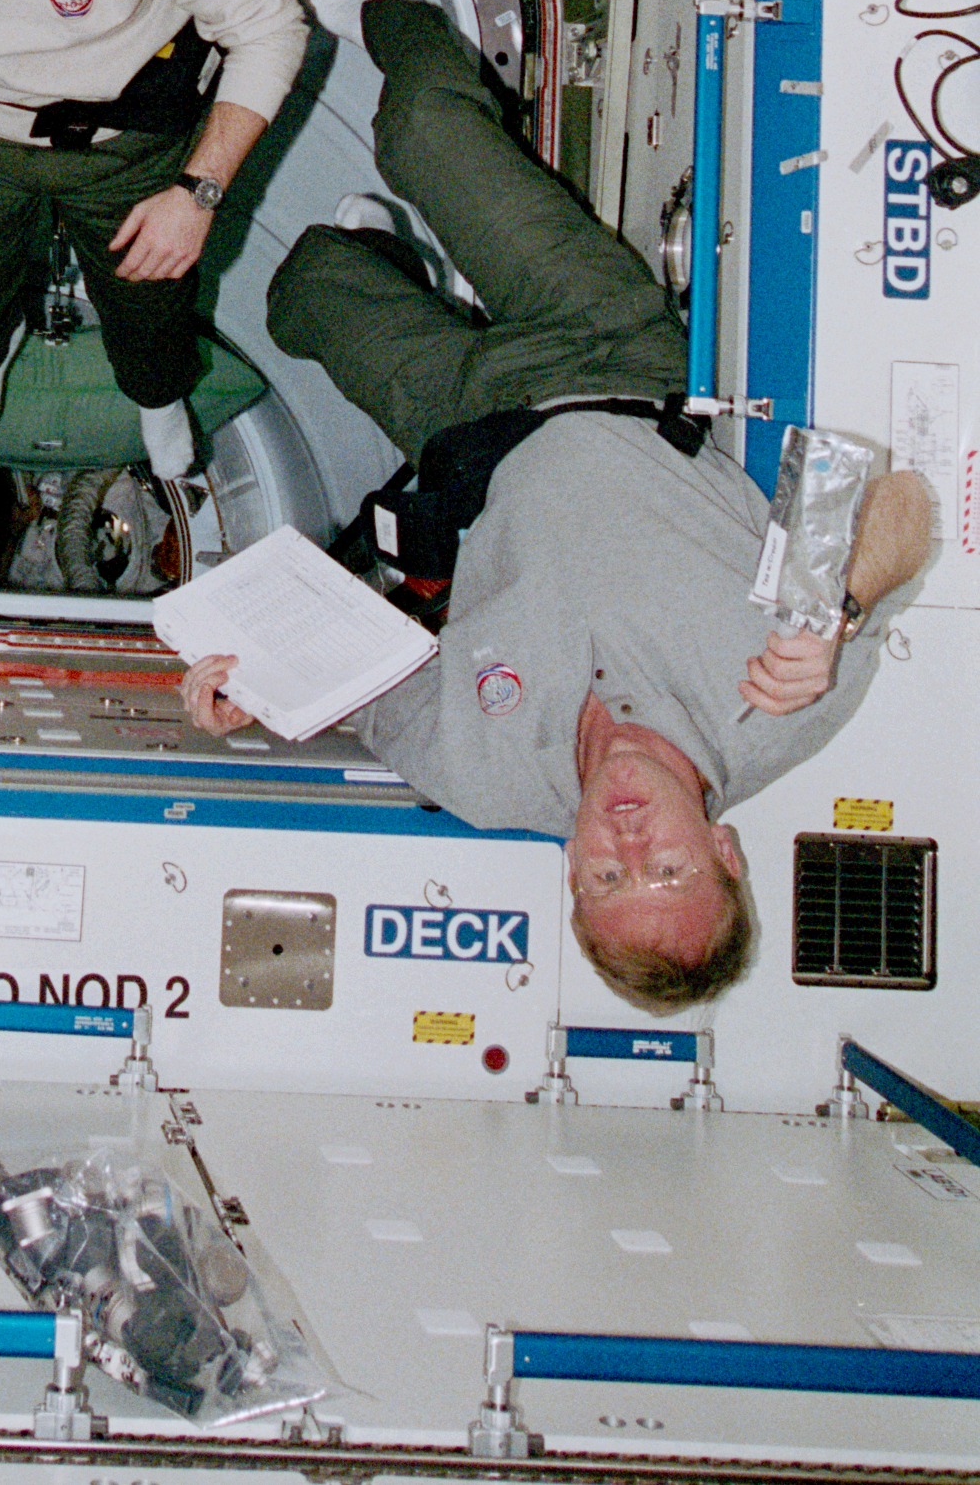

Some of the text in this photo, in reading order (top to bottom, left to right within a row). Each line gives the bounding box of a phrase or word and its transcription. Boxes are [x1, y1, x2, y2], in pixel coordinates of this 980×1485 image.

[887, 148, 928, 291] STBD
[371, 909, 524, 960] DECK
[38, 973, 148, 1009] NOD
[164, 976, 190, 1019] 2
